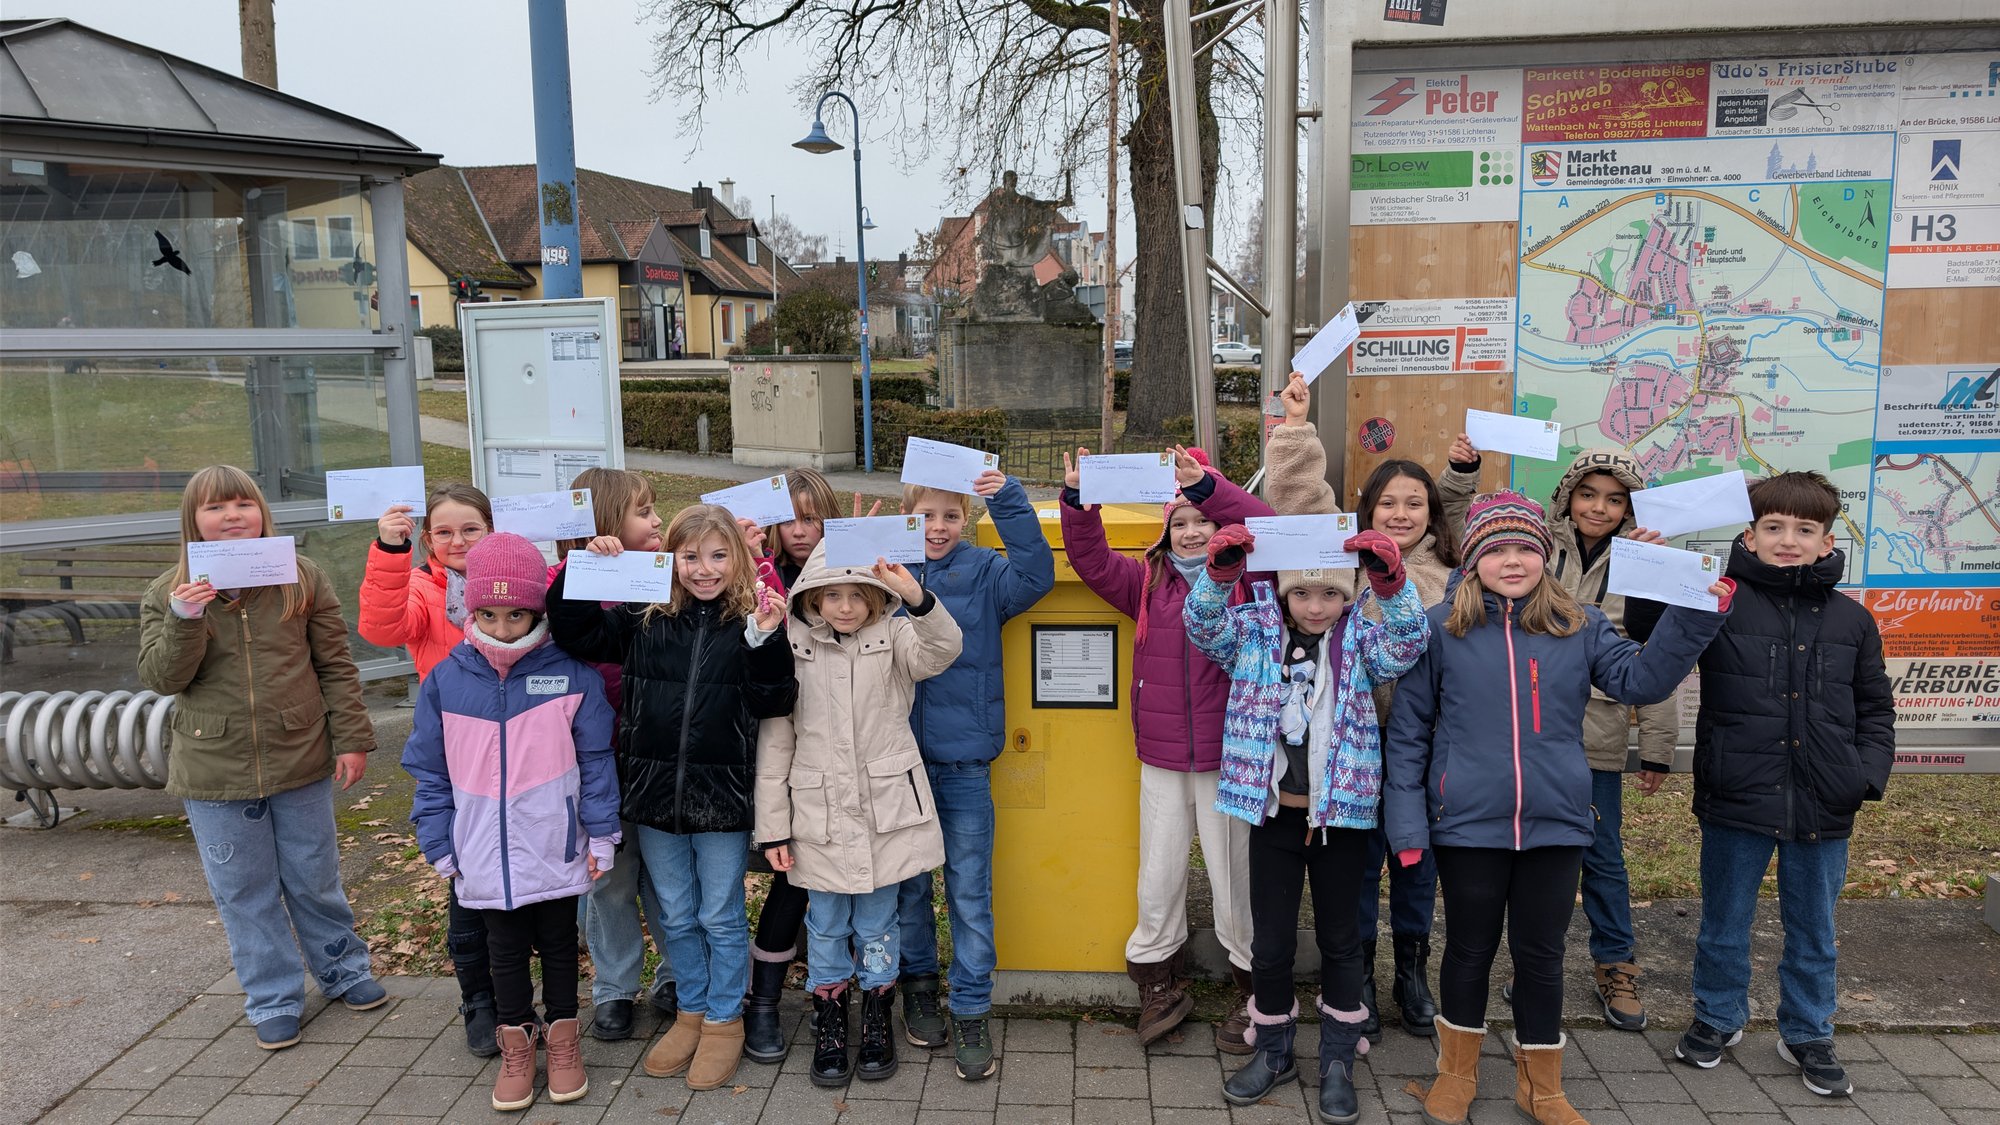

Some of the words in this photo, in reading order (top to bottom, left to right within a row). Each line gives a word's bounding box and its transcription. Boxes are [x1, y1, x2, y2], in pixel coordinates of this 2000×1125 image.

[1527, 69, 1585, 82] Parkett
[1600, 66, 1706, 80] Bodenbeläge
[1718, 64, 1768, 79] Udo's
[1778, 59, 1897, 77] FrisierStube
[1426, 79, 1459, 87] Elektro
[1764, 78, 1785, 87] Voll
[1790, 78, 1804, 86] im
[1810, 76, 1850, 85] Trend!
[1425, 74, 1499, 115] Peter
[1527, 80, 1612, 110] Schwab
[1526, 100, 1612, 122] Fußböden
[1526, 123, 1584, 132] Wattenbach
[1604, 122, 1612, 130] 9
[1619, 120, 1651, 129] 91586
[1654, 119, 1703, 128] Lichtenau
[1724, 115, 1758, 124] Angebot!
[1928, 118, 1958, 126] Brücke,
[1409, 130, 1426, 138] Weg
[1564, 131, 1599, 140] Telefon
[1715, 128, 1751, 136] Ansbacher
[1567, 150, 1617, 163] Markt
[1352, 159, 1374, 173] Dr.
[1378, 156, 1430, 172] Loew
[1566, 164, 1652, 177] Lichtenau
[1772, 170, 1834, 180] Gewerbeverband
[1835, 168, 1872, 178] Lichtenau
[1566, 178, 1626, 187] Gemeindegröße:
[1628, 177, 1644, 185] 41,3
[1645, 177, 1661, 185] qkm
[1667, 175, 1709, 183] Einwohner:
[1723, 174, 1741, 182] 4000
[1929, 183, 1959, 191] PHÖNIX
[1370, 194, 1424, 204] Windsbacher
[1426, 194, 1454, 203] Straße
[1457, 191, 1469, 202] 31
[1655, 192, 1666, 205] B
[1748, 189, 1760, 203] C
[1843, 188, 1855, 201] D
[1864, 189, 1875, 199] N
[1558, 196, 1569, 208] A
[1560, 208, 1596, 233] Staatsstraße
[1595, 198, 1610, 214] 2223
[1756, 208, 1786, 234] Windsbach
[1812, 196, 1879, 248] Eichelberg
[1910, 214, 1957, 242] H3
[1526, 226, 1532, 237] 1
[1616, 233, 1644, 241] Steinbruch
[1527, 234, 1553, 253] Ansbach
[1707, 248, 1729, 256] Grund-
[1546, 262, 1556, 270] AN
[1707, 256, 1746, 264] Hauptschule
[645, 265, 679, 281] Sparkasse
[1376, 314, 1441, 325] Bestattungen
[1522, 314, 1531, 325] 2
[1836, 312, 1874, 326] Immeldorf
[1803, 326, 1846, 335] Sportzentrum
[1729, 338, 1747, 346] Veste
[1356, 339, 1450, 358] SCHILLING
[1356, 364, 1398, 373] Schreinerei
[1401, 364, 1450, 372] Innenausbau
[1520, 402, 1528, 413] 3
[1883, 403, 1966, 412] Beschriftungen
[1920, 458, 1928, 466] A
[1871, 541, 1878, 549] 2
[1873, 590, 1984, 613] Eberhardt
[1920, 755, 1932, 763] DI
[1936, 755, 1966, 764] AMICI
